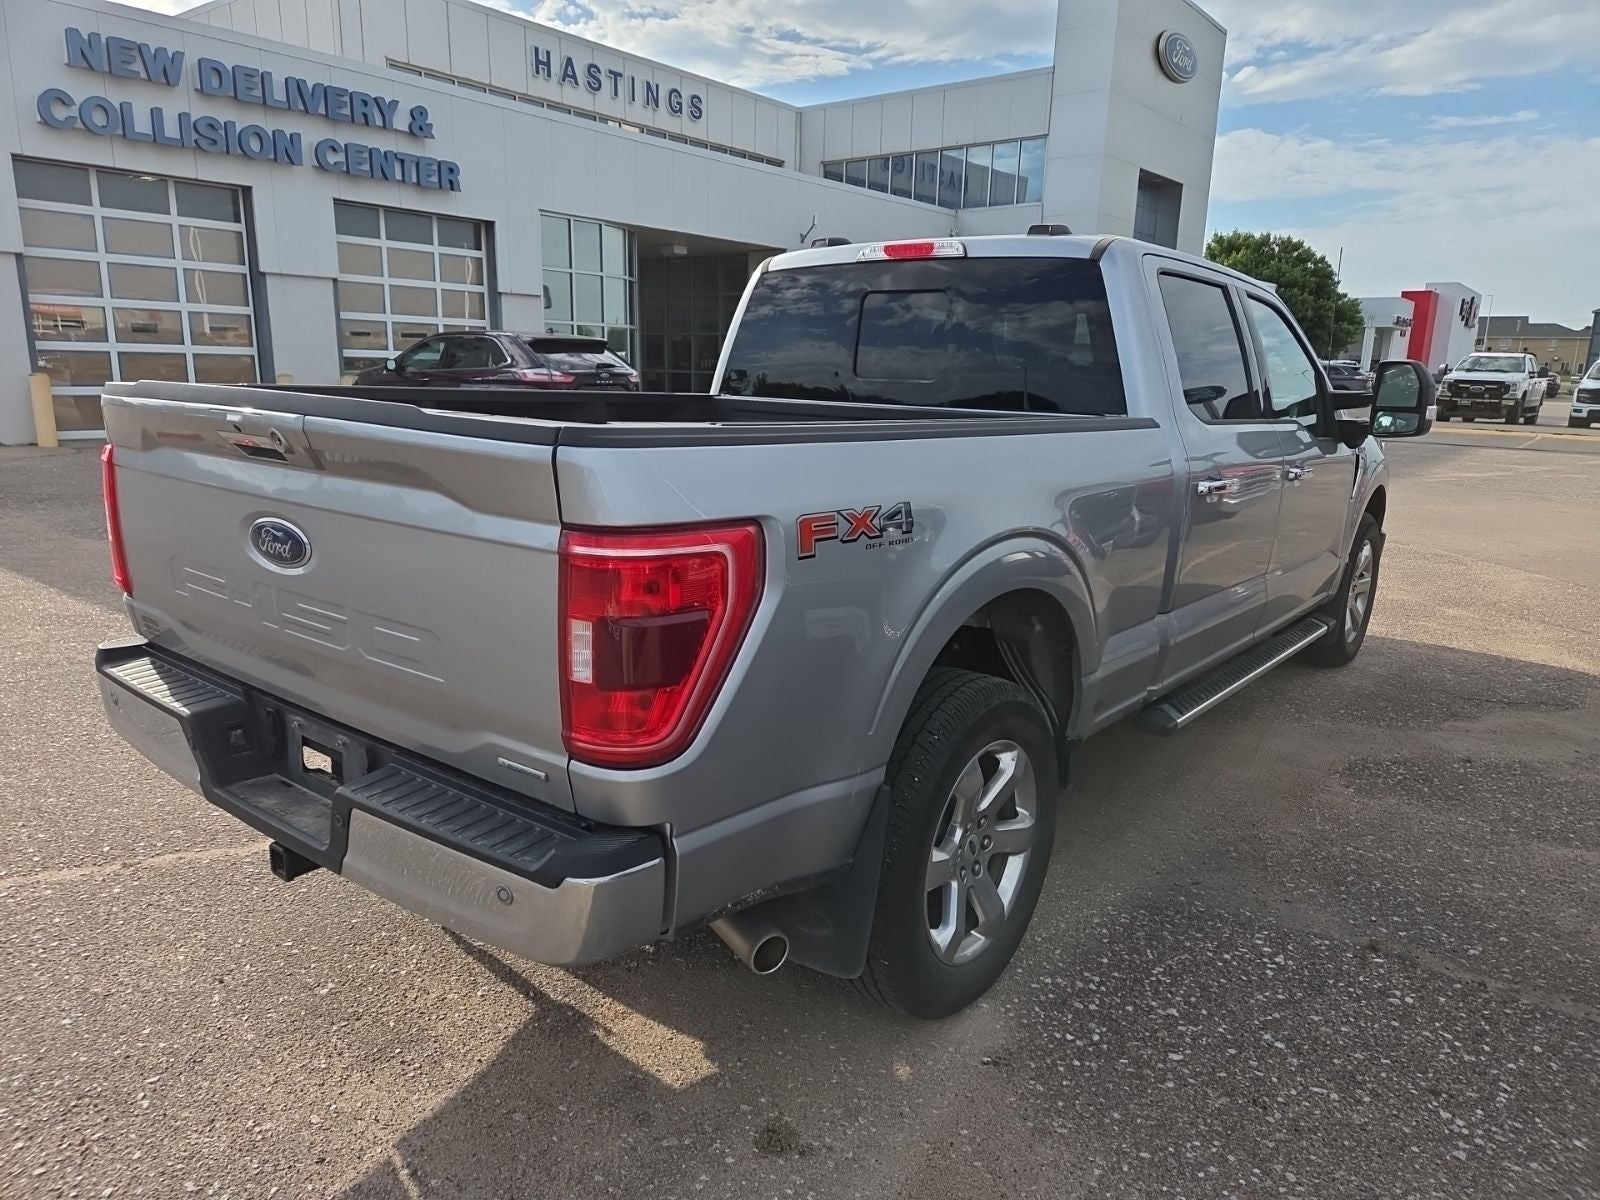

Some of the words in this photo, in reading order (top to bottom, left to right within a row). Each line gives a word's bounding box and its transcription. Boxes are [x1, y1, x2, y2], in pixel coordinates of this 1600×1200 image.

[64, 27, 185, 87] NEW
[194, 57, 400, 130] DELIVERY
[408, 104, 435, 139] &
[532, 45, 704, 121] HASTINGS
[1172, 39, 1194, 73] Ford
[36, 87, 304, 167] COLLISION
[312, 137, 462, 192] CENTER
[258, 527, 292, 558] Ford
[796, 501, 914, 560] FX4
[865, 543, 885, 551] OFF
